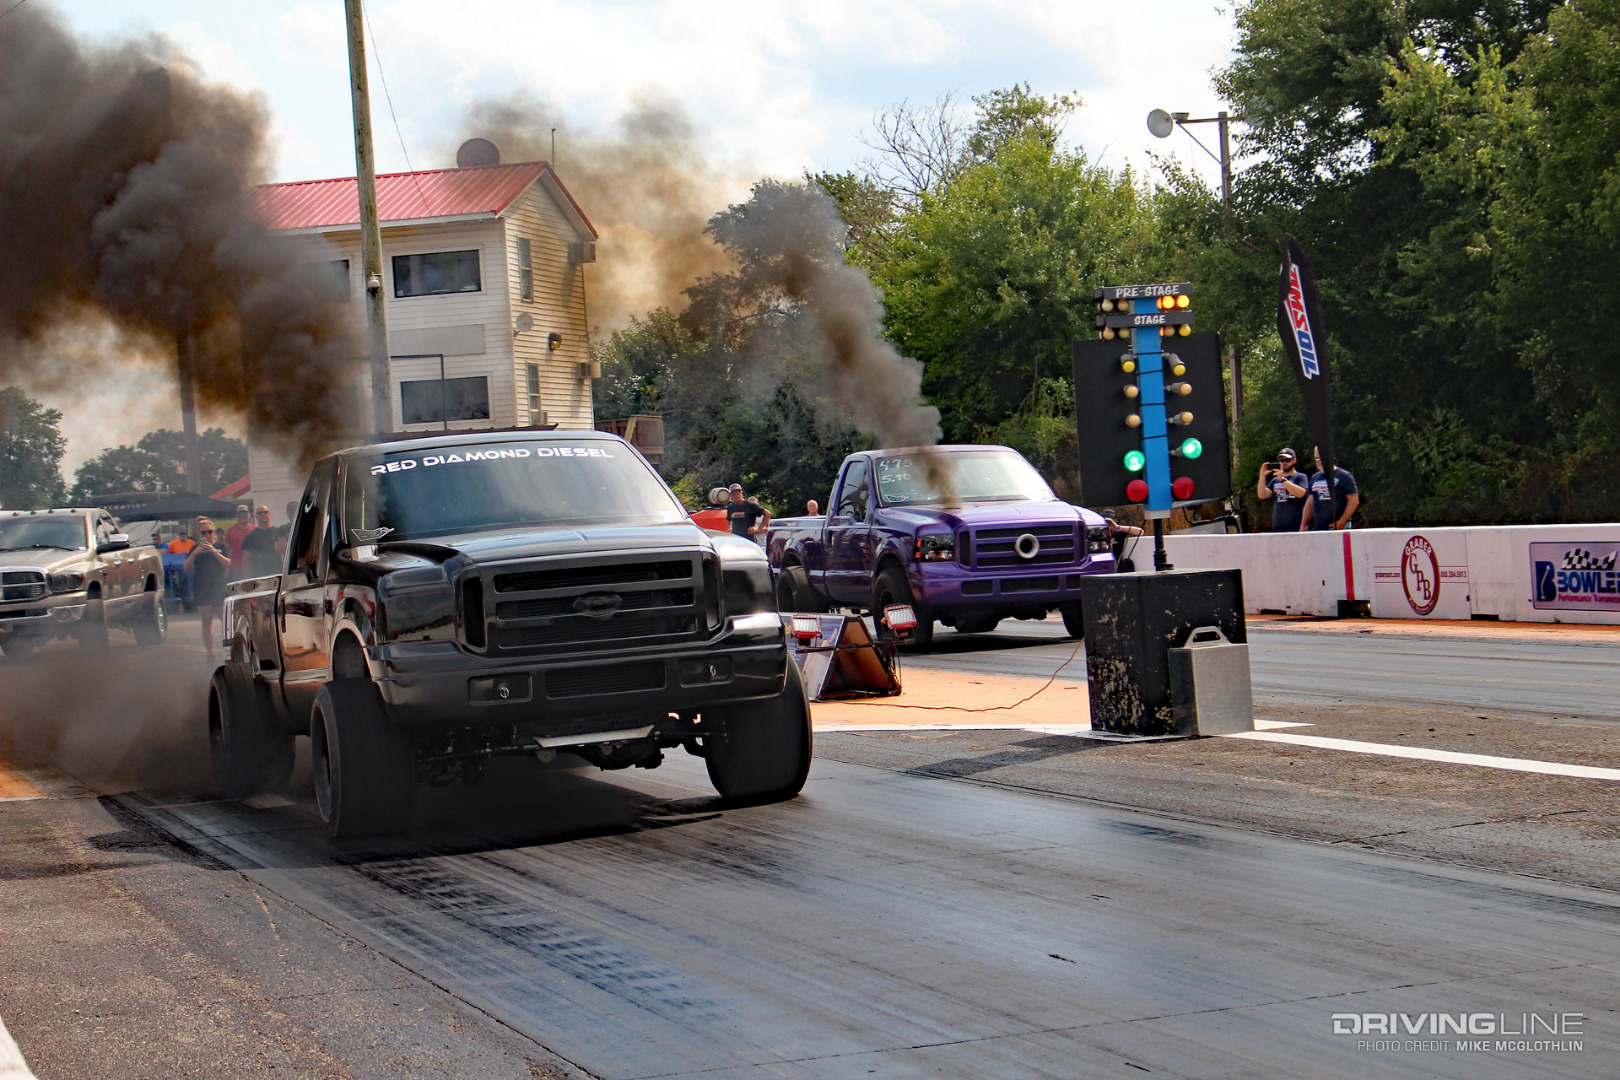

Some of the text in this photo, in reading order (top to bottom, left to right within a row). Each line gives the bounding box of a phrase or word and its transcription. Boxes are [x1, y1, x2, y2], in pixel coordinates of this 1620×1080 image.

[1116, 284, 1180, 298] PRE-STAGE
[1134, 315, 1166, 325] STAGE
[370, 447, 615, 476] RED DIAMOND DIESEL
[880, 459, 913, 471] 475
[1405, 538, 1432, 557] GRABER
[1558, 593, 1592, 602] Performance
